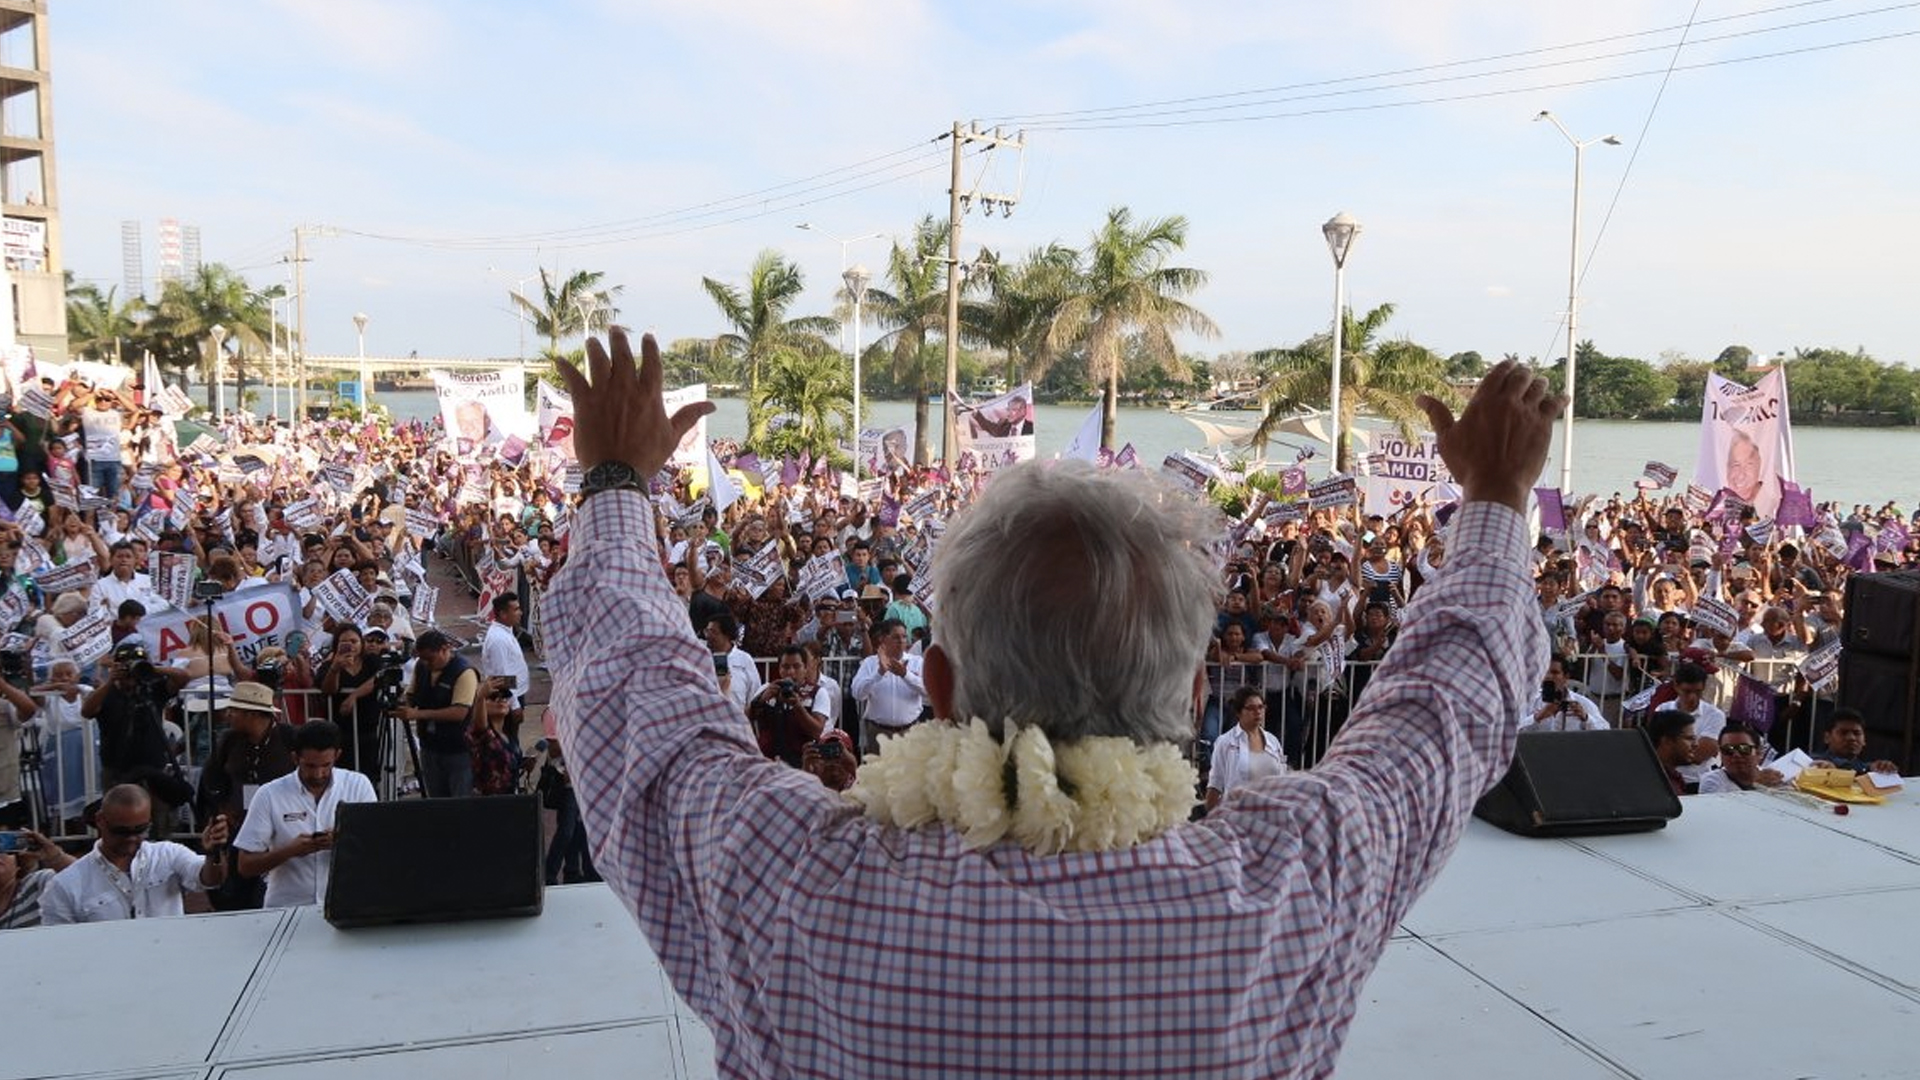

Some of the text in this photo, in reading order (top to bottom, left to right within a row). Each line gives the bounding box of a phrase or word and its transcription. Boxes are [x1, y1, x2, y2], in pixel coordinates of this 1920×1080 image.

[1380, 440, 1425, 459] VOTA
[317, 583, 352, 618] morena
[159, 601, 279, 662] ALO
